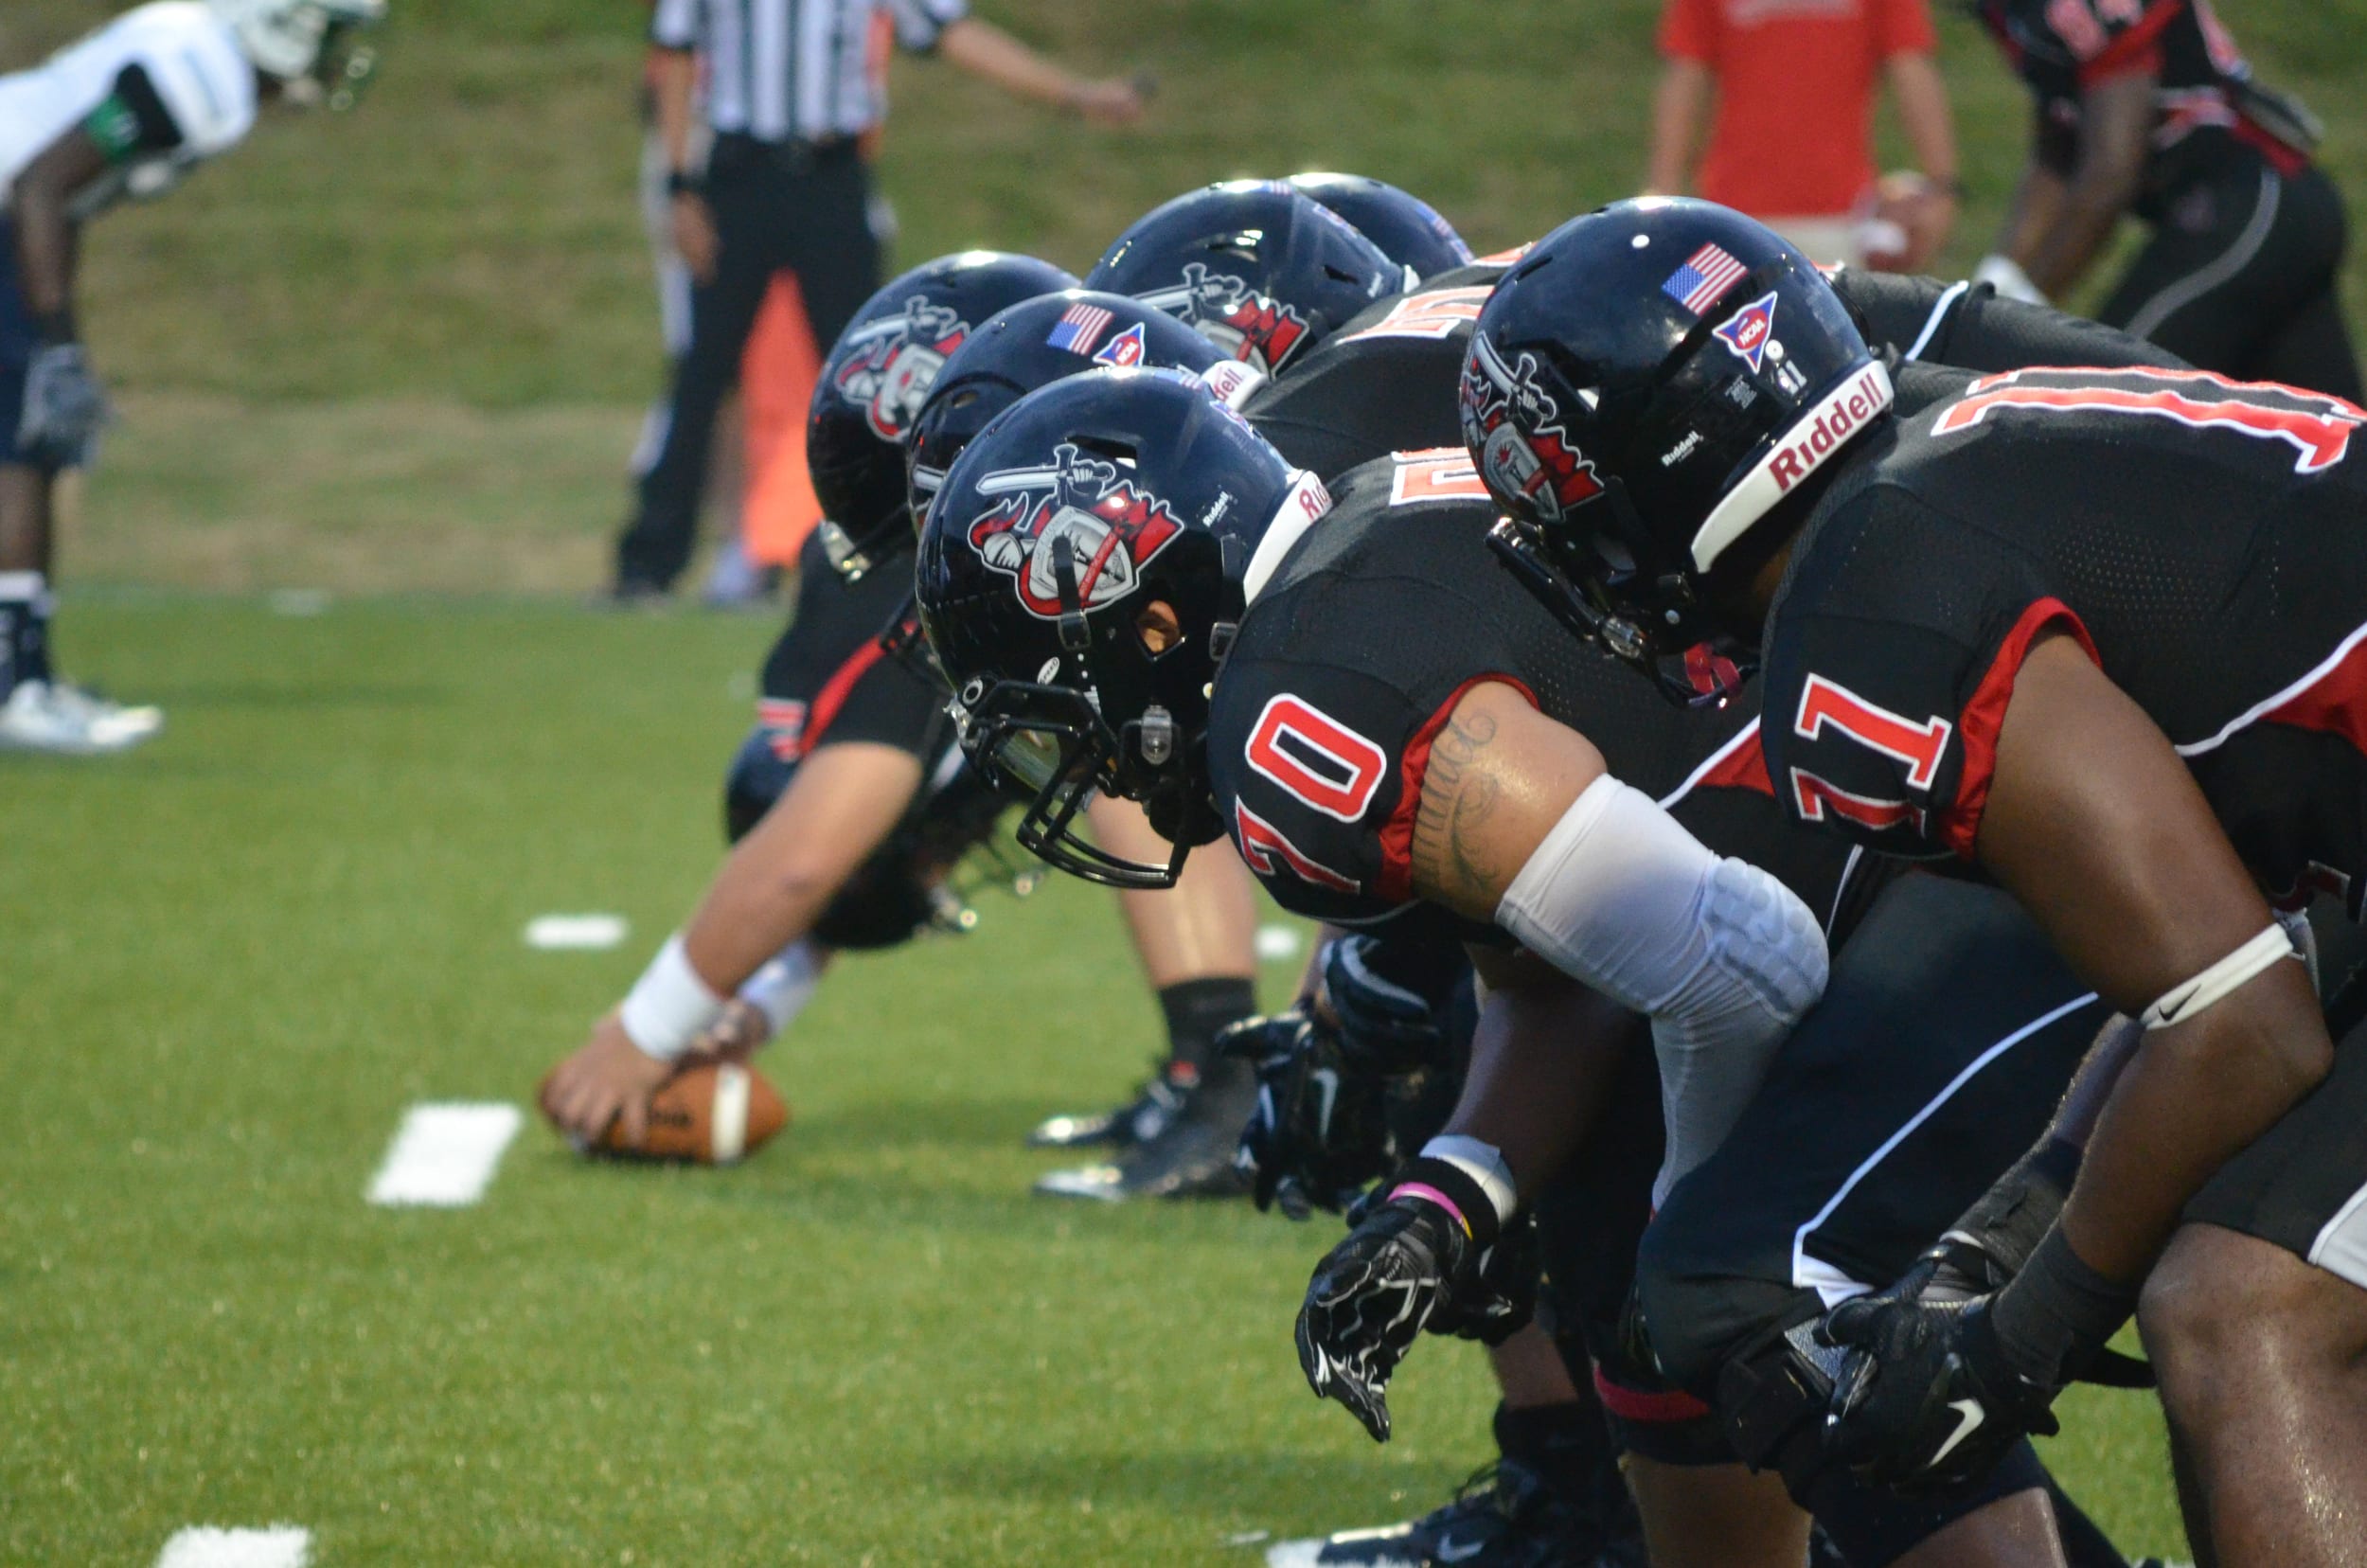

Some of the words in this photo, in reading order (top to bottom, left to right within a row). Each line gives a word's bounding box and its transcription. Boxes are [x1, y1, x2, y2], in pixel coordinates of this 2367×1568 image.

[1661, 430, 1700, 467] Riddell
[1769, 371, 1884, 492] Riddell
[1235, 692, 1388, 895] 70
